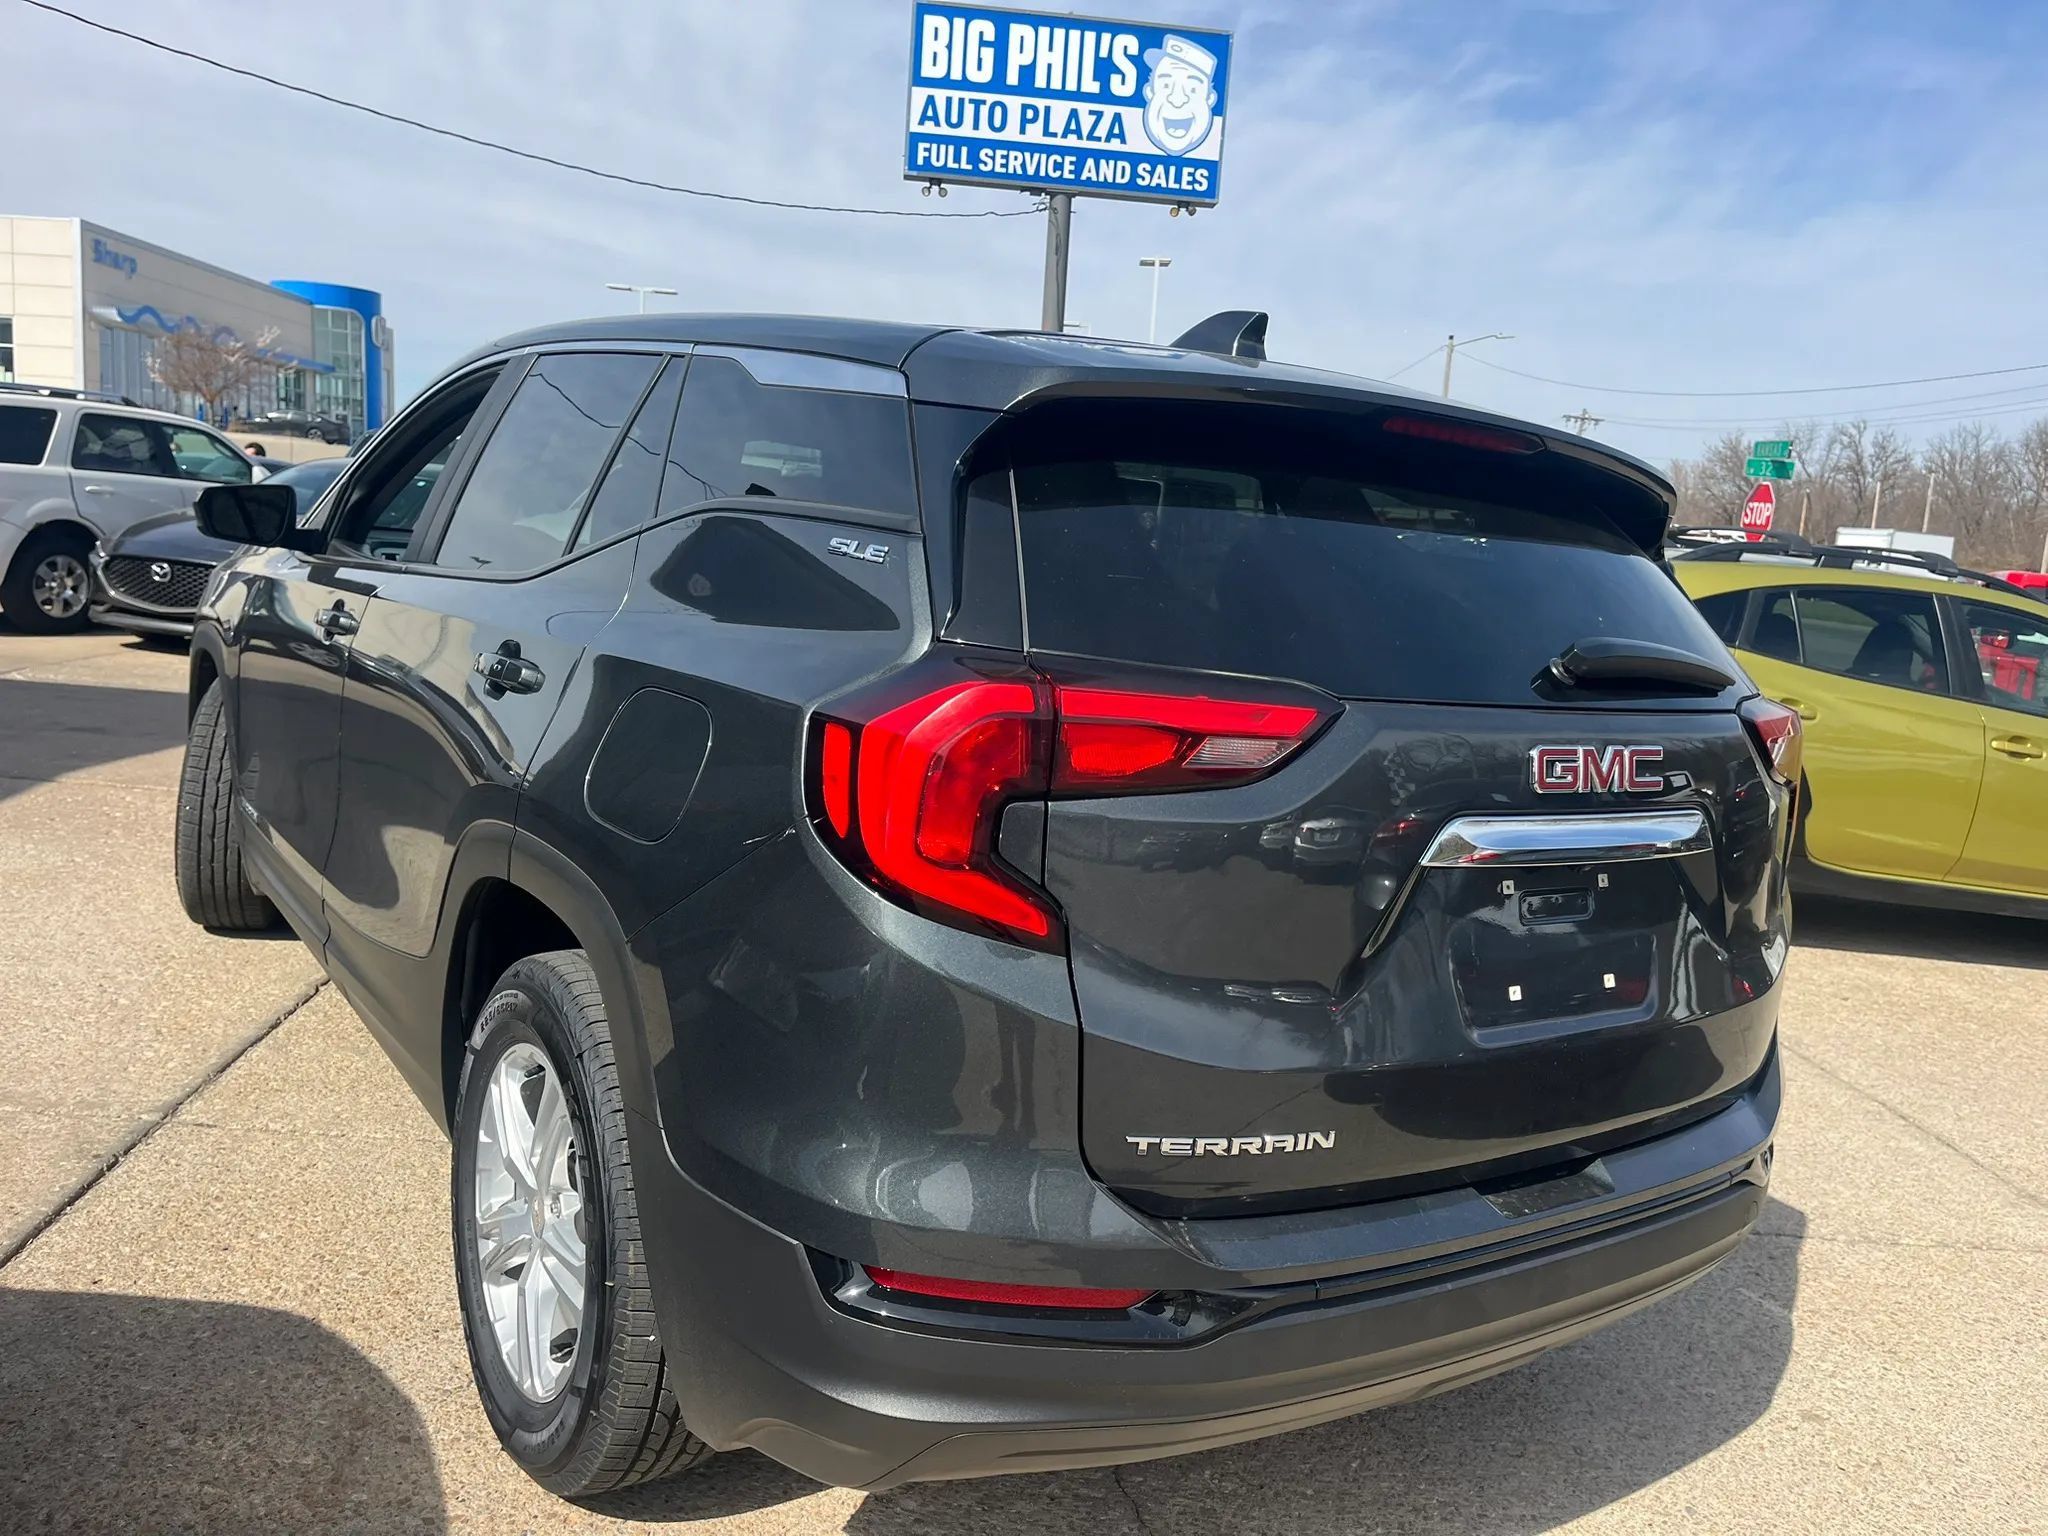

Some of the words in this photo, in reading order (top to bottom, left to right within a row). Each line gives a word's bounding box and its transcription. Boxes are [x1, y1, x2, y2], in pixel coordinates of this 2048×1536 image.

[920, 14, 996, 84] BIG
[1005, 23, 1139, 98] PHIL'S
[918, 94, 1008, 133] AUTO
[1019, 103, 1127, 146] PLAZA
[917, 142, 973, 170] FULL
[978, 149, 1076, 180] SERVICE
[1080, 158, 1131, 184] AND
[1136, 163, 1209, 192] SALES
[93, 238, 137, 279] Sharp
[1760, 461, 1773, 476] 32
[1744, 502, 1772, 525] STOP
[827, 537, 889, 564] SLE
[1530, 744, 1664, 794] GMC
[1125, 1130, 1336, 1157] TERRAIN
